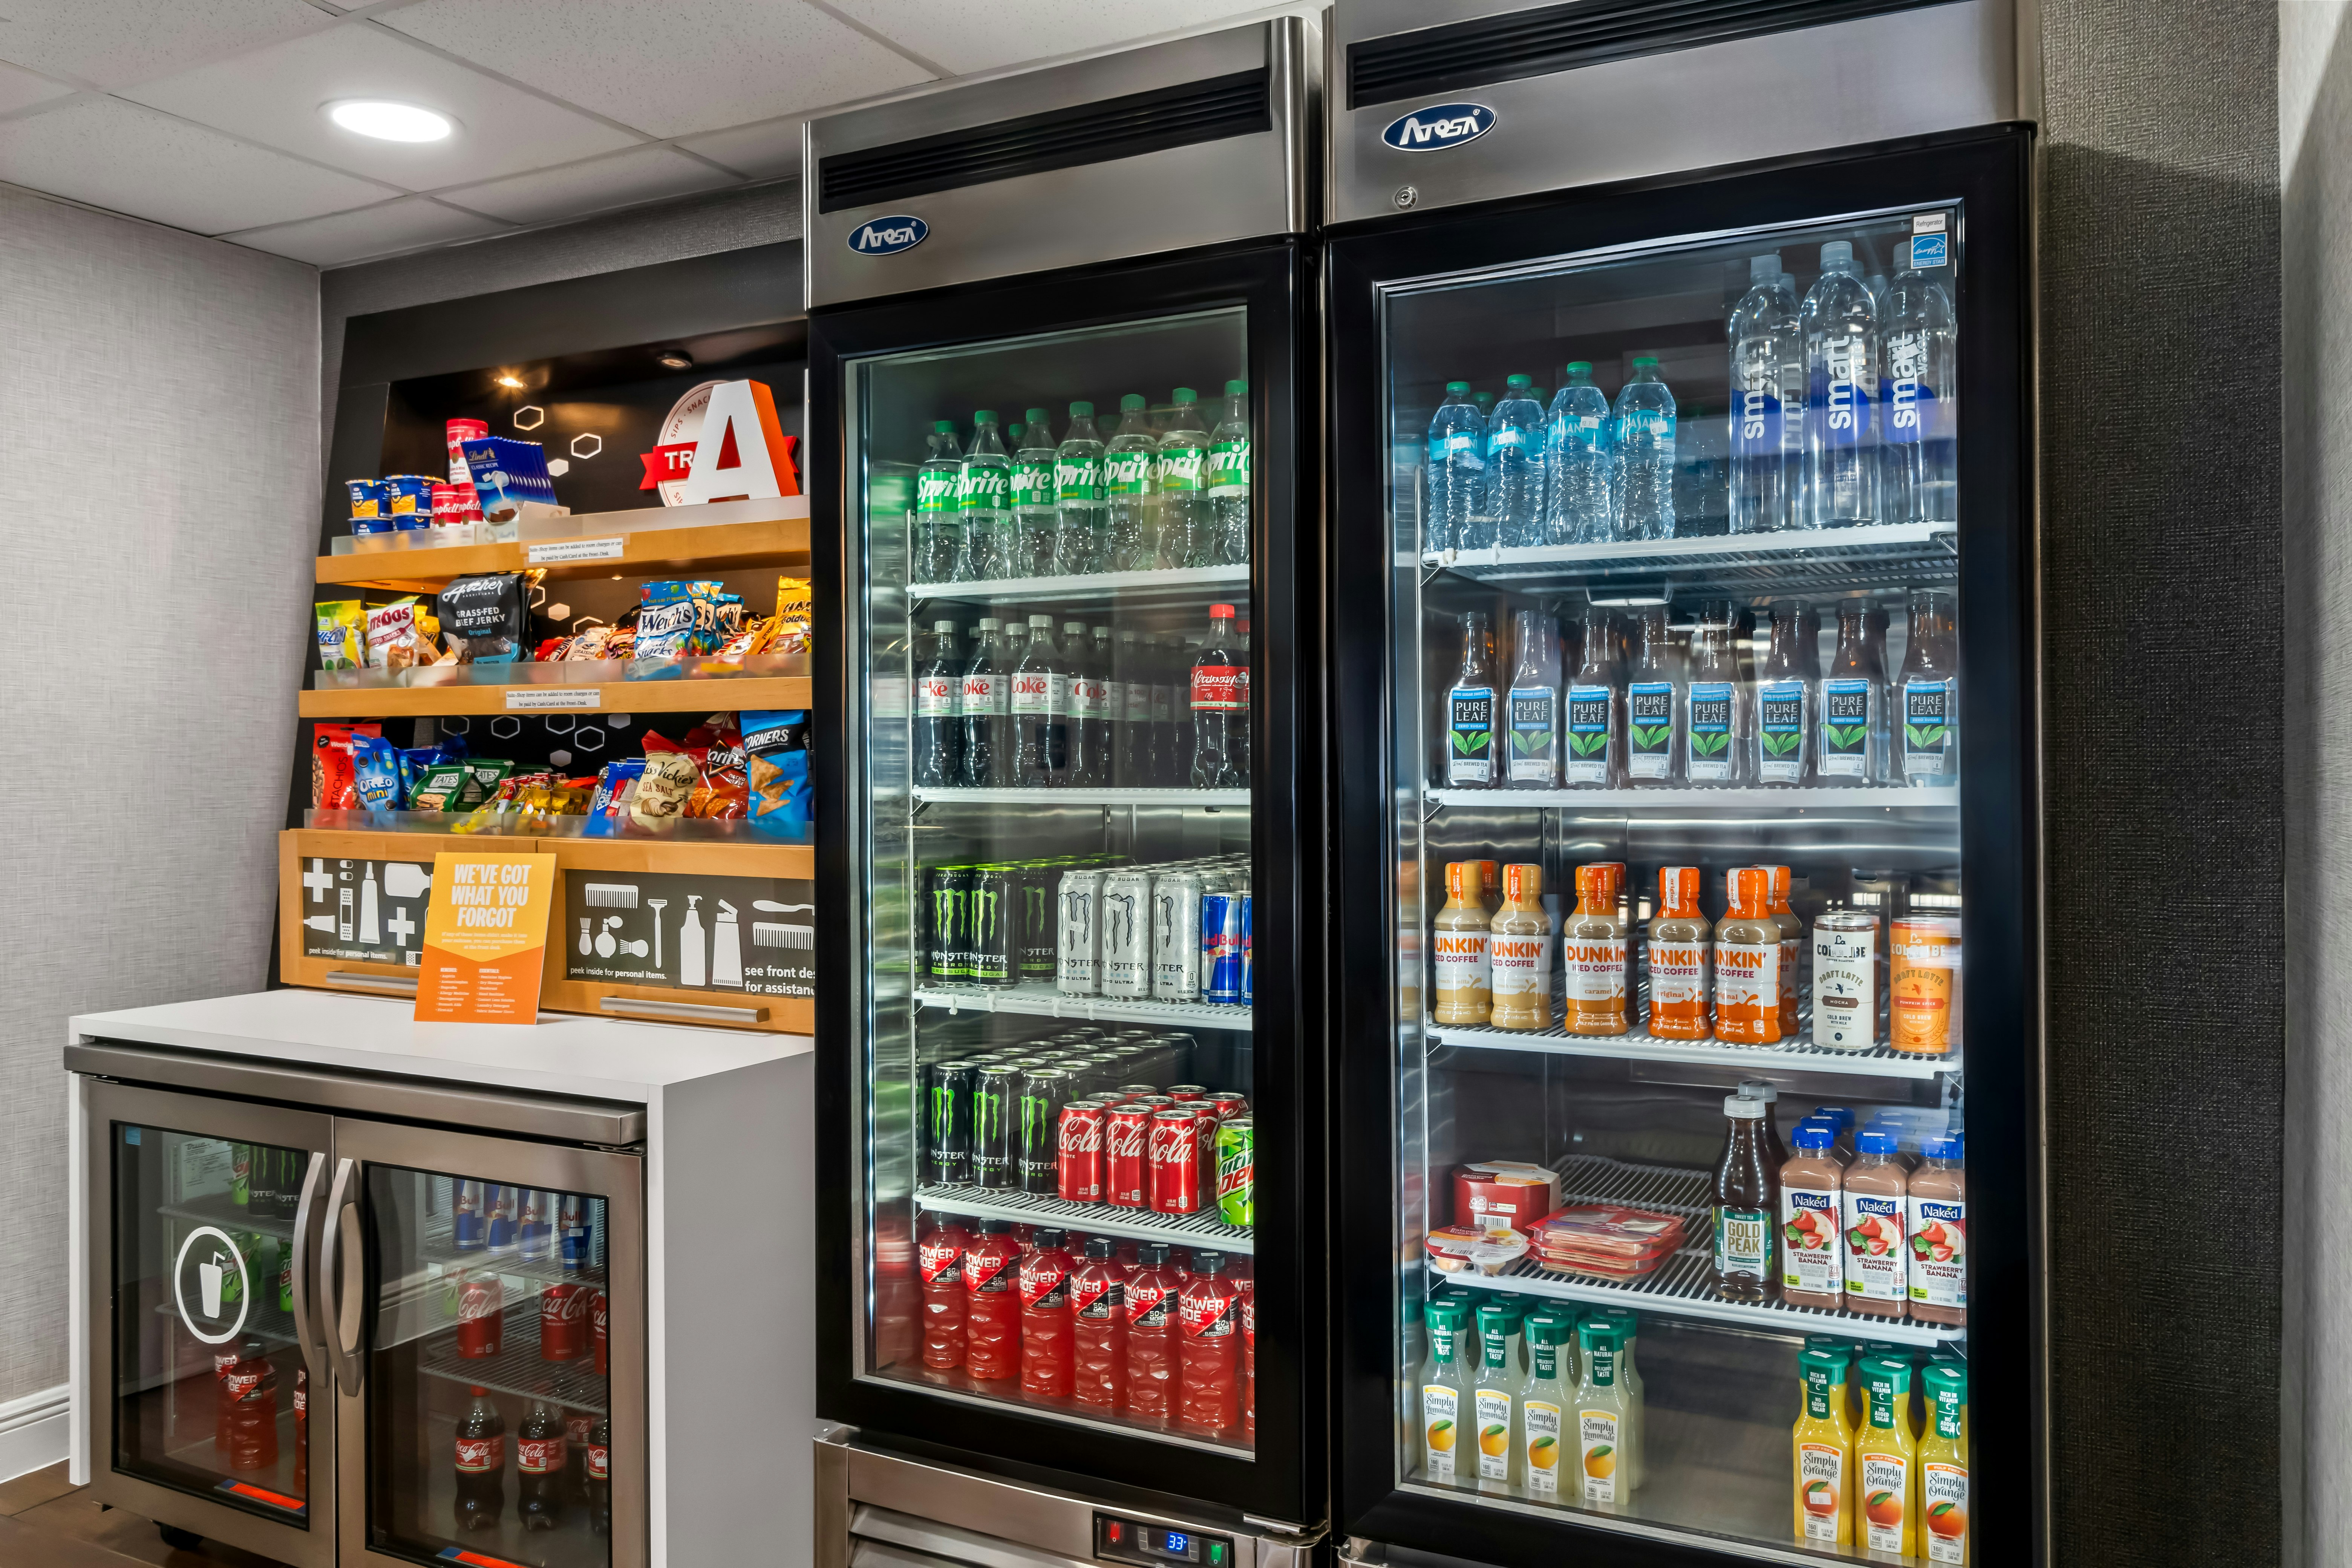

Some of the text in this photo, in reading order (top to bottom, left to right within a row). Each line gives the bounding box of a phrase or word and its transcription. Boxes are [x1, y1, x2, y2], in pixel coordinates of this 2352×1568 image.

[1824, 335, 1851, 429] smart
[687, 395, 710, 413] SNAC
[671, 418, 683, 439] SIPS
[469, 449, 488, 462] Lindt
[456, 606, 499, 618] GRASS-FED
[455, 614, 505, 627] BEEF JERKY
[1456, 702, 1487, 711] PURE
[1516, 701, 1548, 711] PURE
[1636, 696, 1668, 705] PURE
[1832, 696, 1863, 706] PURE
[1911, 695, 1942, 705] PURE
[1573, 703, 1605, 713] PURE
[1695, 704, 1726, 713] PURE
[1767, 704, 1798, 713] PURE
[435, 773, 458, 784] TATE'S
[642, 781, 674, 796] SEA SALT
[455, 864, 532, 885] WE'VE GOT
[451, 886, 529, 906] WHAT YOU
[457, 907, 517, 928] FORGOT
[1834, 935, 1846, 945] La
[309, 947, 321, 956] peek
[322, 948, 336, 956] inside
[345, 950, 369, 960] personal
[570, 966, 667, 980] peek inside for personal items.
[745, 965, 796, 978] see front
[1819, 970, 1864, 987] DRAFT LATTE
[745, 981, 763, 993] for
[1795, 1195, 1828, 1208] Naked
[1860, 1201, 1894, 1213] Naked
[1924, 1206, 1958, 1219] Naked
[1727, 1221, 1760, 1239] GOLD
[1727, 1236, 1760, 1253] PEAK
[1793, 1252, 1833, 1261] STRAWBERRY
[1798, 1257, 1828, 1265] BANANA
[1857, 1258, 1898, 1267] STRAWBERRY
[1862, 1263, 1893, 1272] BANANA
[1921, 1263, 1963, 1273] STRAWBERRY
[1926, 1269, 1958, 1279] BANANA
[1180, 1295, 1225, 1311] POWER
[1180, 1306, 1202, 1322] ADE
[1486, 1332, 1505, 1341] NATURAL
[1872, 1386, 1891, 1394] VITAMIN
[1426, 1393, 1455, 1410] Simply
[1426, 1404, 1456, 1418] Lemonade
[1527, 1409, 1558, 1427] Simply
[1527, 1421, 1558, 1434] Lemonade
[1583, 1418, 1615, 1436] Simply
[1583, 1430, 1615, 1442] Lemonade
[1804, 1452, 1838, 1473] Simply
[1803, 1464, 1838, 1480] Orange
[1867, 1462, 1902, 1484] Simply
[1866, 1475, 1902, 1490] Orange
[1929, 1472, 1965, 1493] Simply
[1929, 1485, 1965, 1501] Orange
[1169, 1535, 1183, 1550] 33
